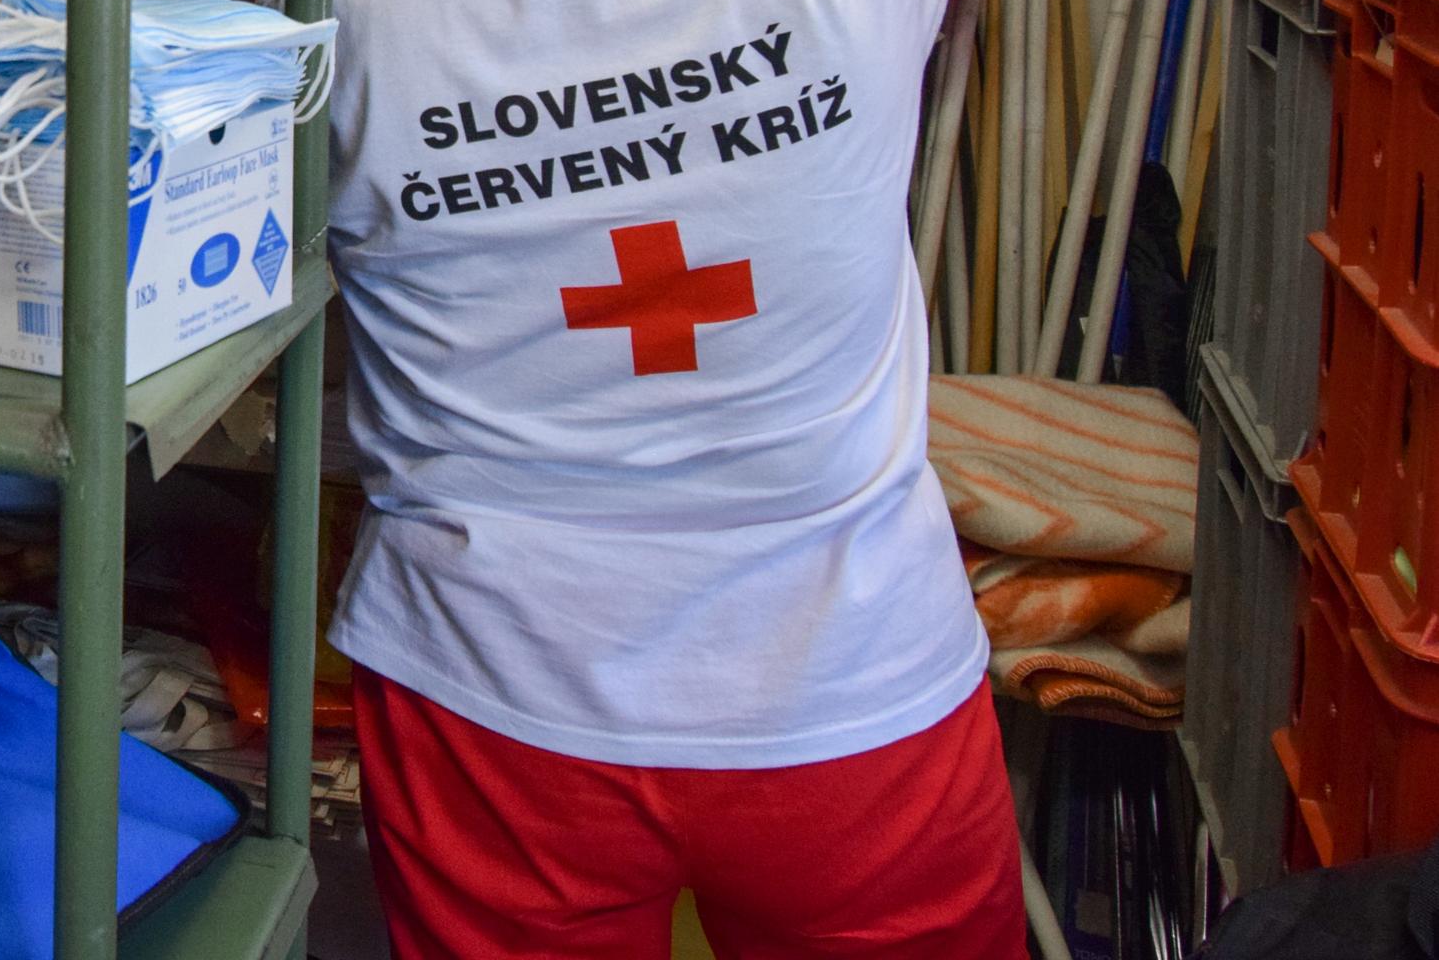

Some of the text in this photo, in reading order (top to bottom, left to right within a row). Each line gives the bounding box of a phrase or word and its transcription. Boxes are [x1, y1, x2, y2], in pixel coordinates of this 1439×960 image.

[419, 22, 792, 149] SLOVENSKÝ
[165, 167, 204, 203] Standard
[240, 156, 257, 176] Face
[259, 144, 279, 168] Mask
[400, 75, 852, 221] ČERVENÝ KRÍŽ
[136, 282, 157, 309] 1826
